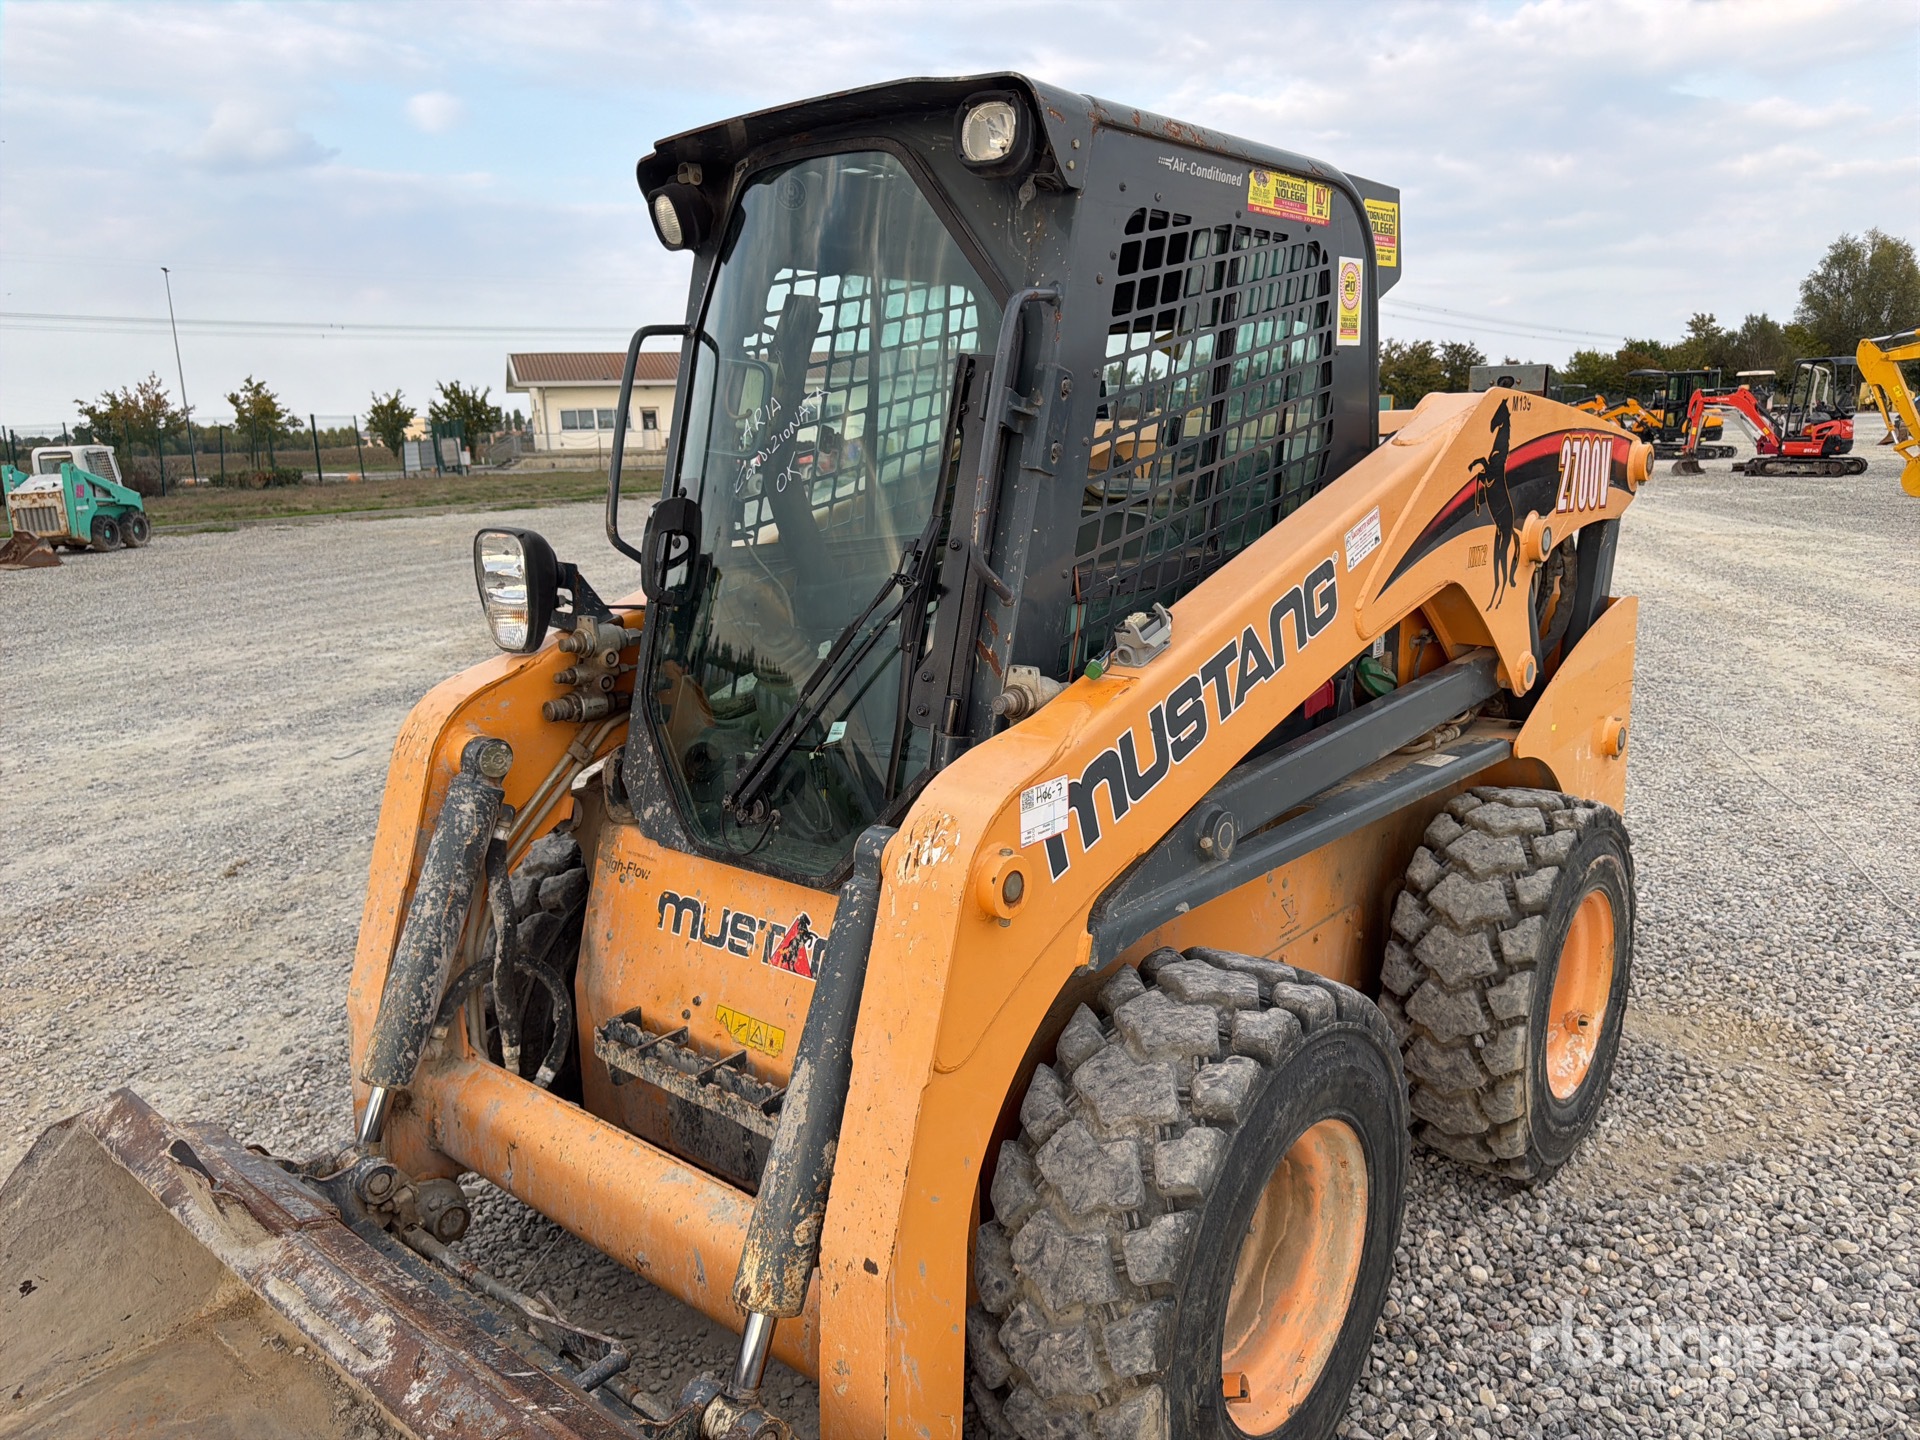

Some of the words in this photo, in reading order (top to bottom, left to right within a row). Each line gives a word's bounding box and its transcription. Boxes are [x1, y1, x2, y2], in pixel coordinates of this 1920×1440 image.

[1172, 157, 1243, 187] Air-Conditioned
[743, 397, 782, 446] ARIA
[776, 451, 803, 493] OK
[1555, 435, 1612, 514] 2700V
[1044, 557, 1339, 883] MUSTANG
